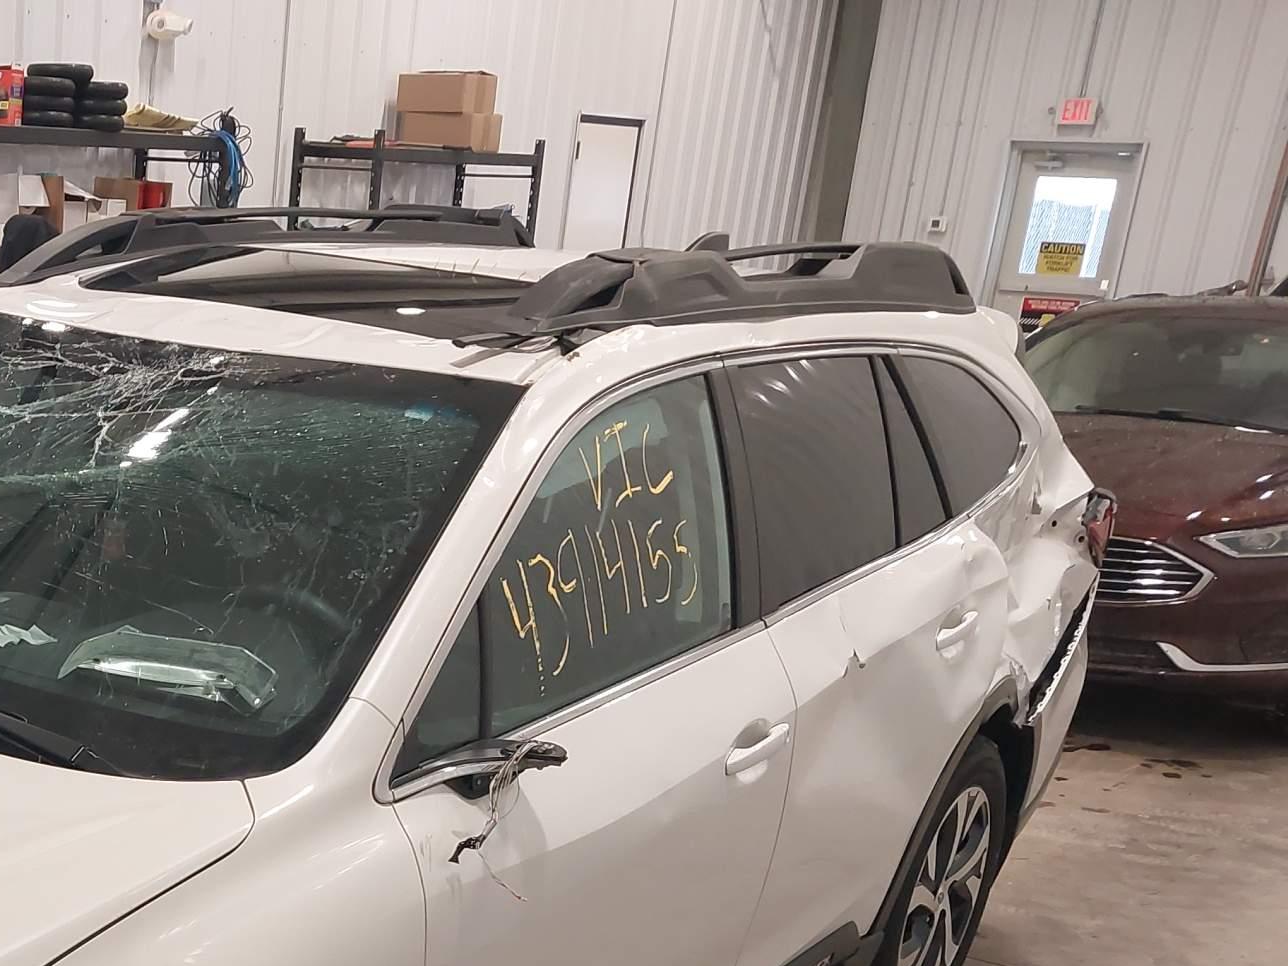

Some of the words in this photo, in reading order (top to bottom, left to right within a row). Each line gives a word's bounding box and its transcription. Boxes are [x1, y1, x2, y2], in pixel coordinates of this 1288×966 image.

[1062, 99, 1093, 121] EXIT
[1041, 244, 1084, 254] CAUTION
[501, 519, 698, 677] 43914155
